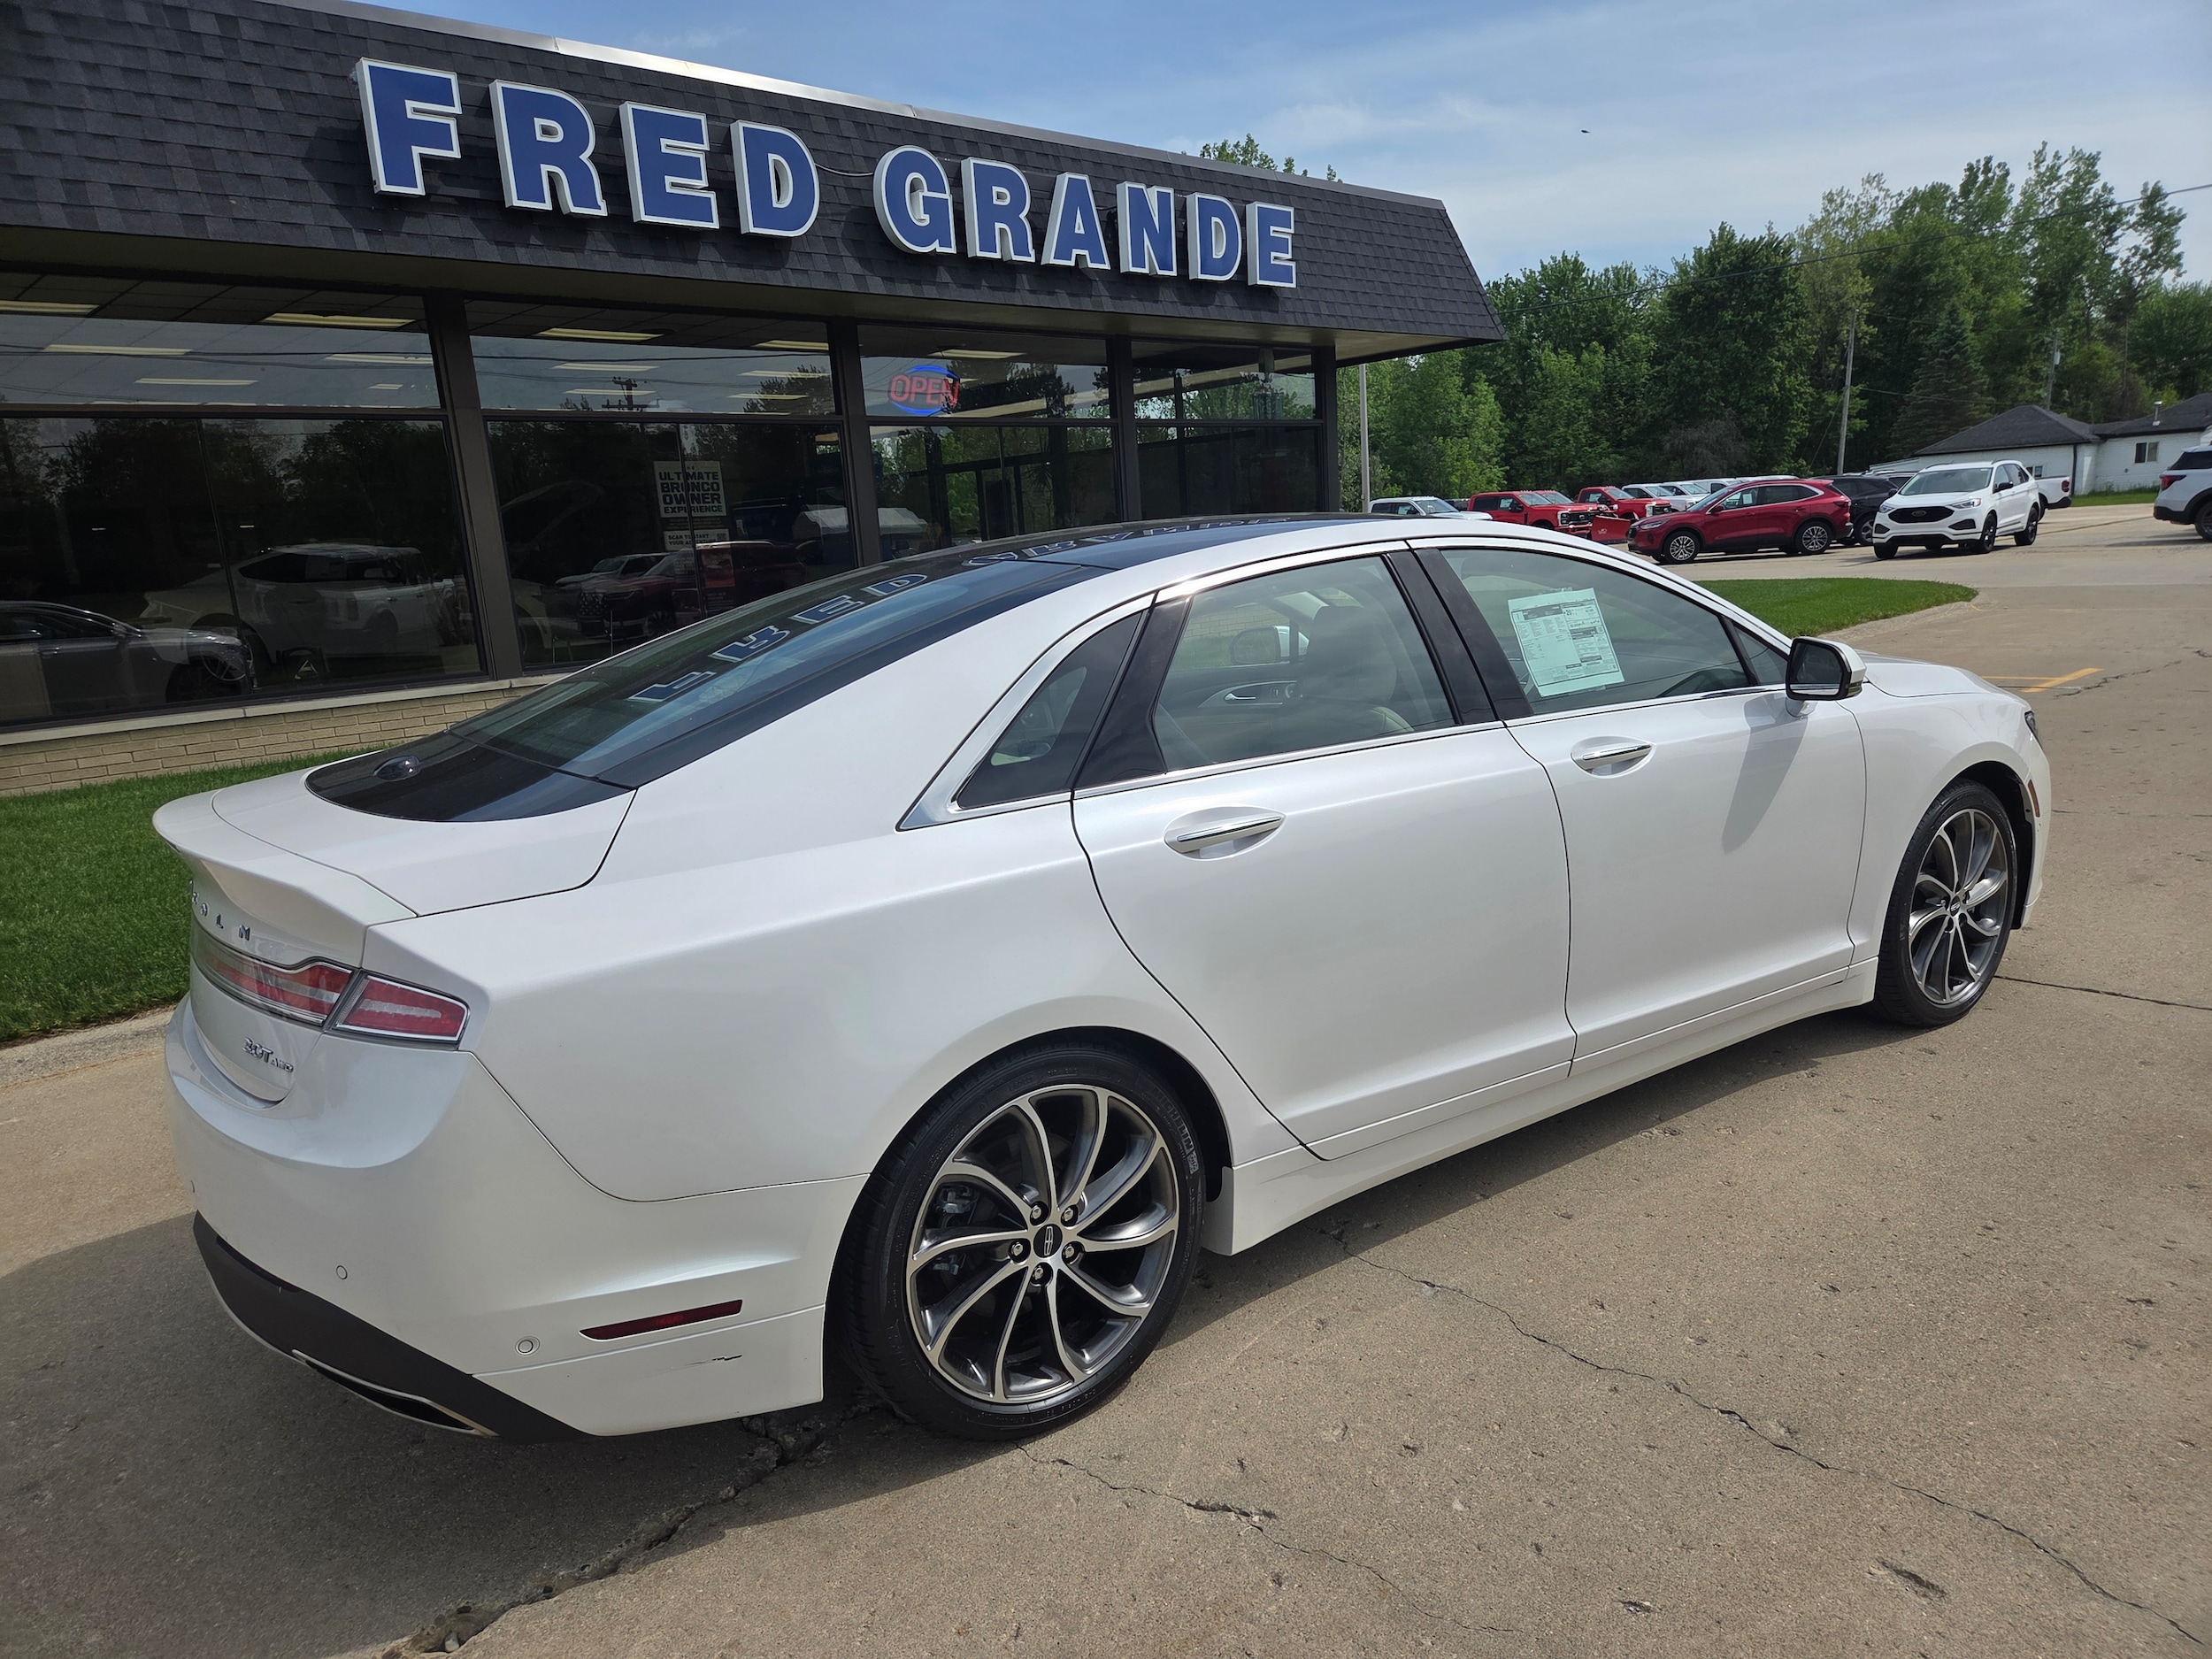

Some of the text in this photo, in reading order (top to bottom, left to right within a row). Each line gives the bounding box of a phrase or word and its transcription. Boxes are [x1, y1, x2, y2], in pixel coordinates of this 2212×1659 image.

[357, 58, 1296, 288] FRED GRANDE
[889, 374, 960, 407] OPEN
[658, 472, 718, 481] ULTMATE
[662, 493, 722, 505] OWNER
